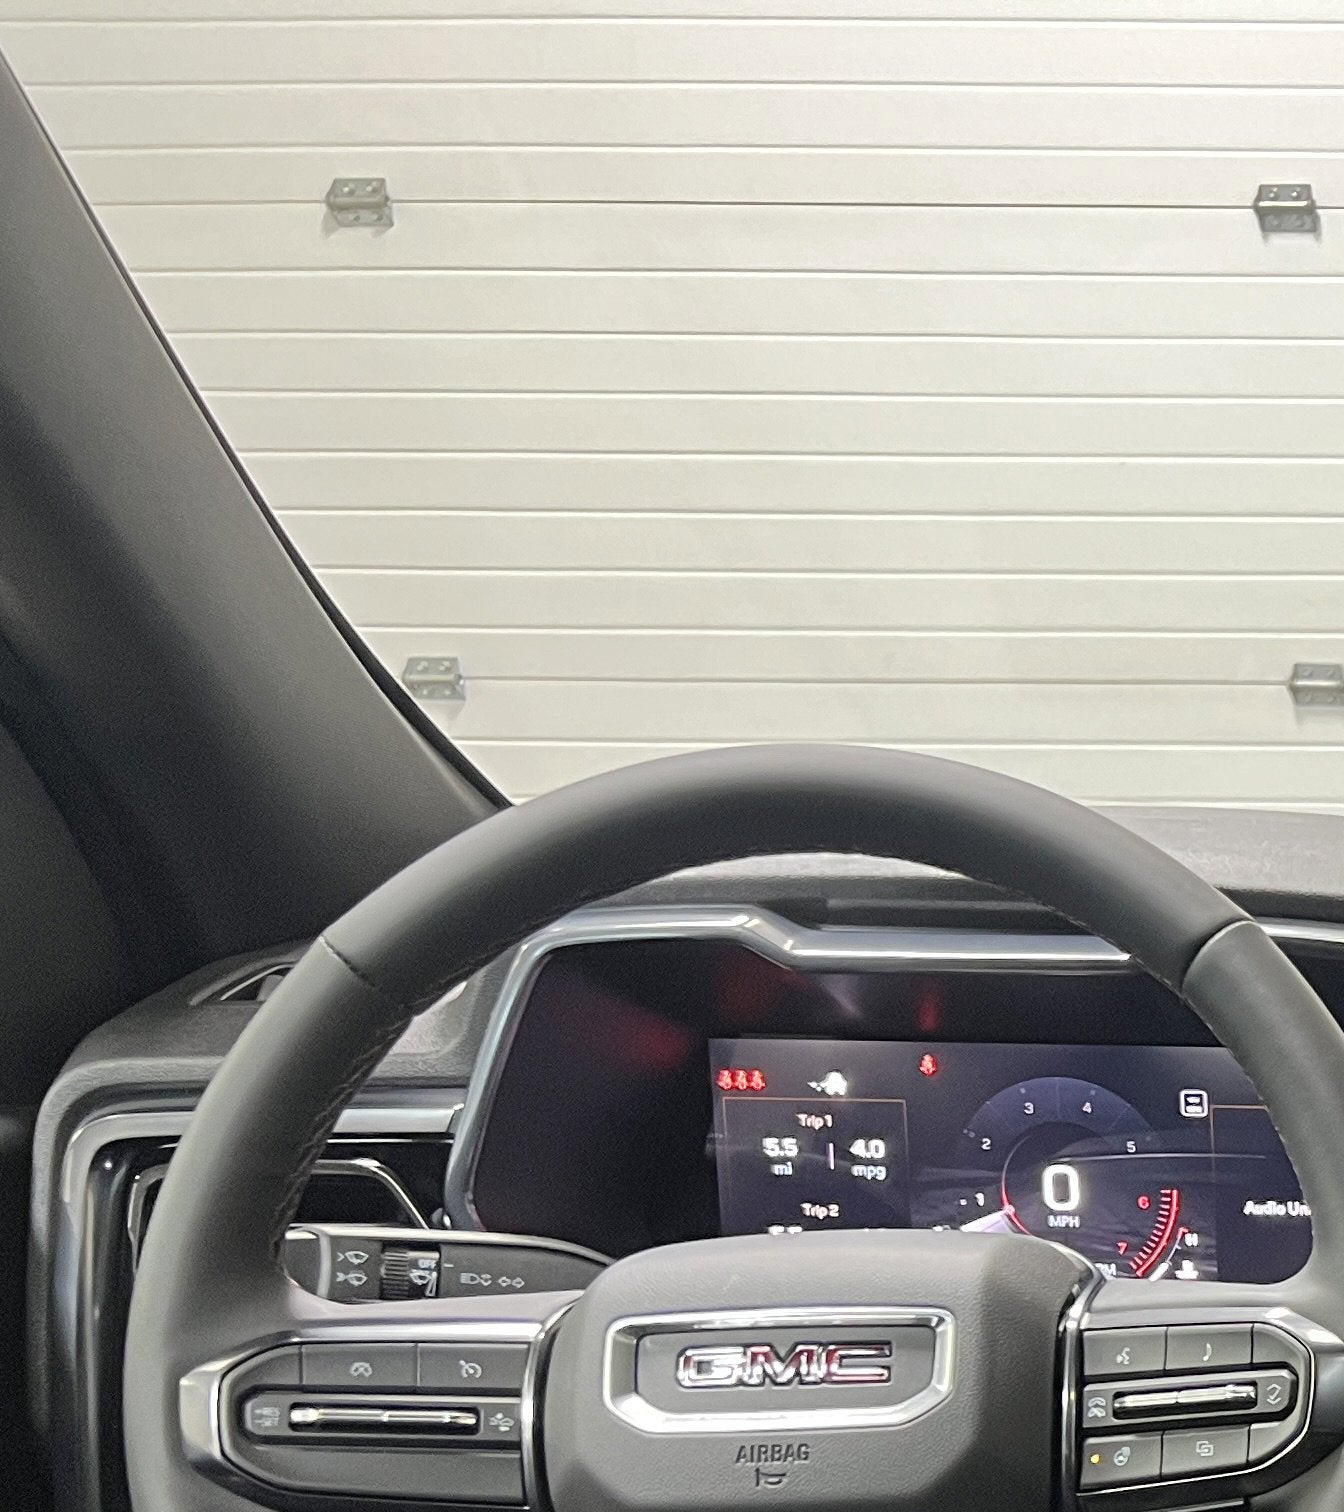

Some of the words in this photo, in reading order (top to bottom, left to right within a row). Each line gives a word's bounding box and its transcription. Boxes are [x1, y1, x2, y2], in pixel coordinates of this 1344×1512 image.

[1023, 1102, 1035, 1115] 3
[1082, 1101, 1093, 1114] 4
[797, 1113, 825, 1131] Trip
[761, 1137, 799, 1158] 5.5
[848, 1138, 886, 1160] 4.0
[981, 1138, 992, 1151] 2
[1126, 1141, 1137, 1154] 5
[771, 1161, 793, 1177] mi
[850, 1165, 887, 1181] mpg
[1042, 1163, 1081, 1212] 0
[975, 1192, 985, 1208] 1
[1138, 1196, 1150, 1210] 6
[800, 1203, 828, 1220] Trip
[828, 1204, 840, 1218] 2
[1242, 1200, 1287, 1217] Audio
[1047, 1215, 1080, 1228] MPH
[1116, 1241, 1128, 1256] 7
[677, 1341, 892, 1390] GMC
[735, 1443, 810, 1464] AIRBAG
